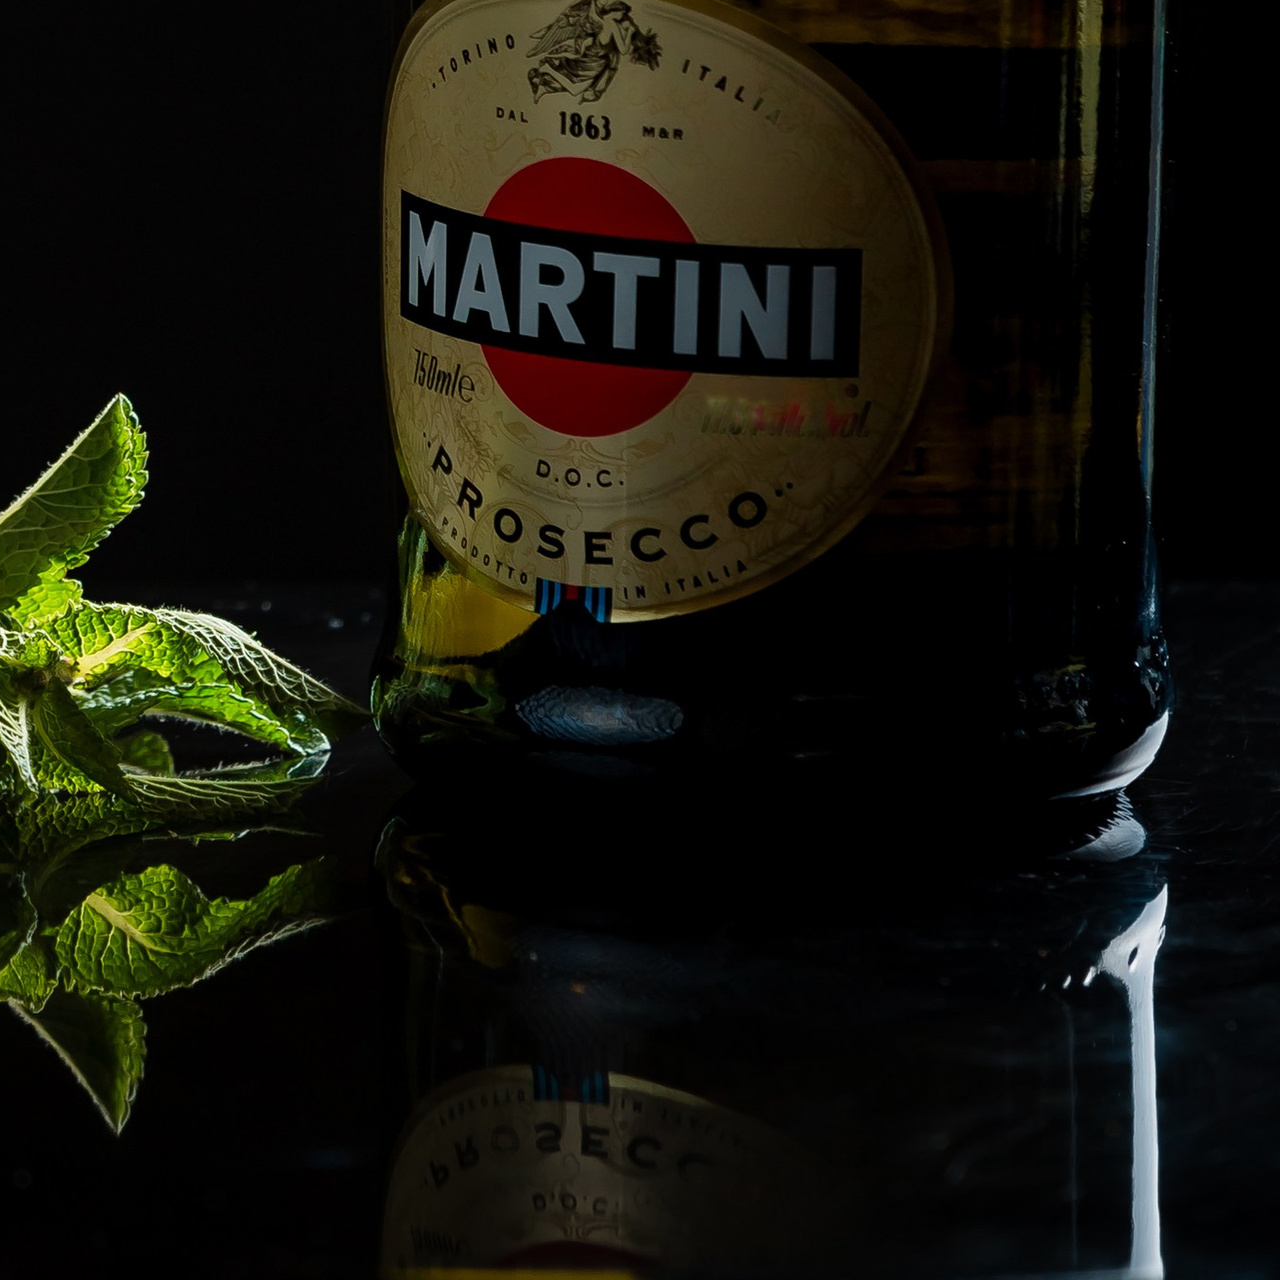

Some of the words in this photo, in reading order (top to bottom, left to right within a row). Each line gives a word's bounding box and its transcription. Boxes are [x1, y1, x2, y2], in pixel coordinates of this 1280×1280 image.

[437, 33, 517, 83] TORINO
[496, 107, 528, 123] DAL
[559, 111, 612, 142] 1863
[641, 125, 684, 141] M&R
[407, 210, 837, 362] MARTINI
[431, 444, 767, 566] PROSECCO
[537, 458, 625, 488] D.O.C.
[441, 515, 529, 585] PRODOTTO
[623, 583, 646, 600] IN
[665, 559, 748, 595] ITALIA
